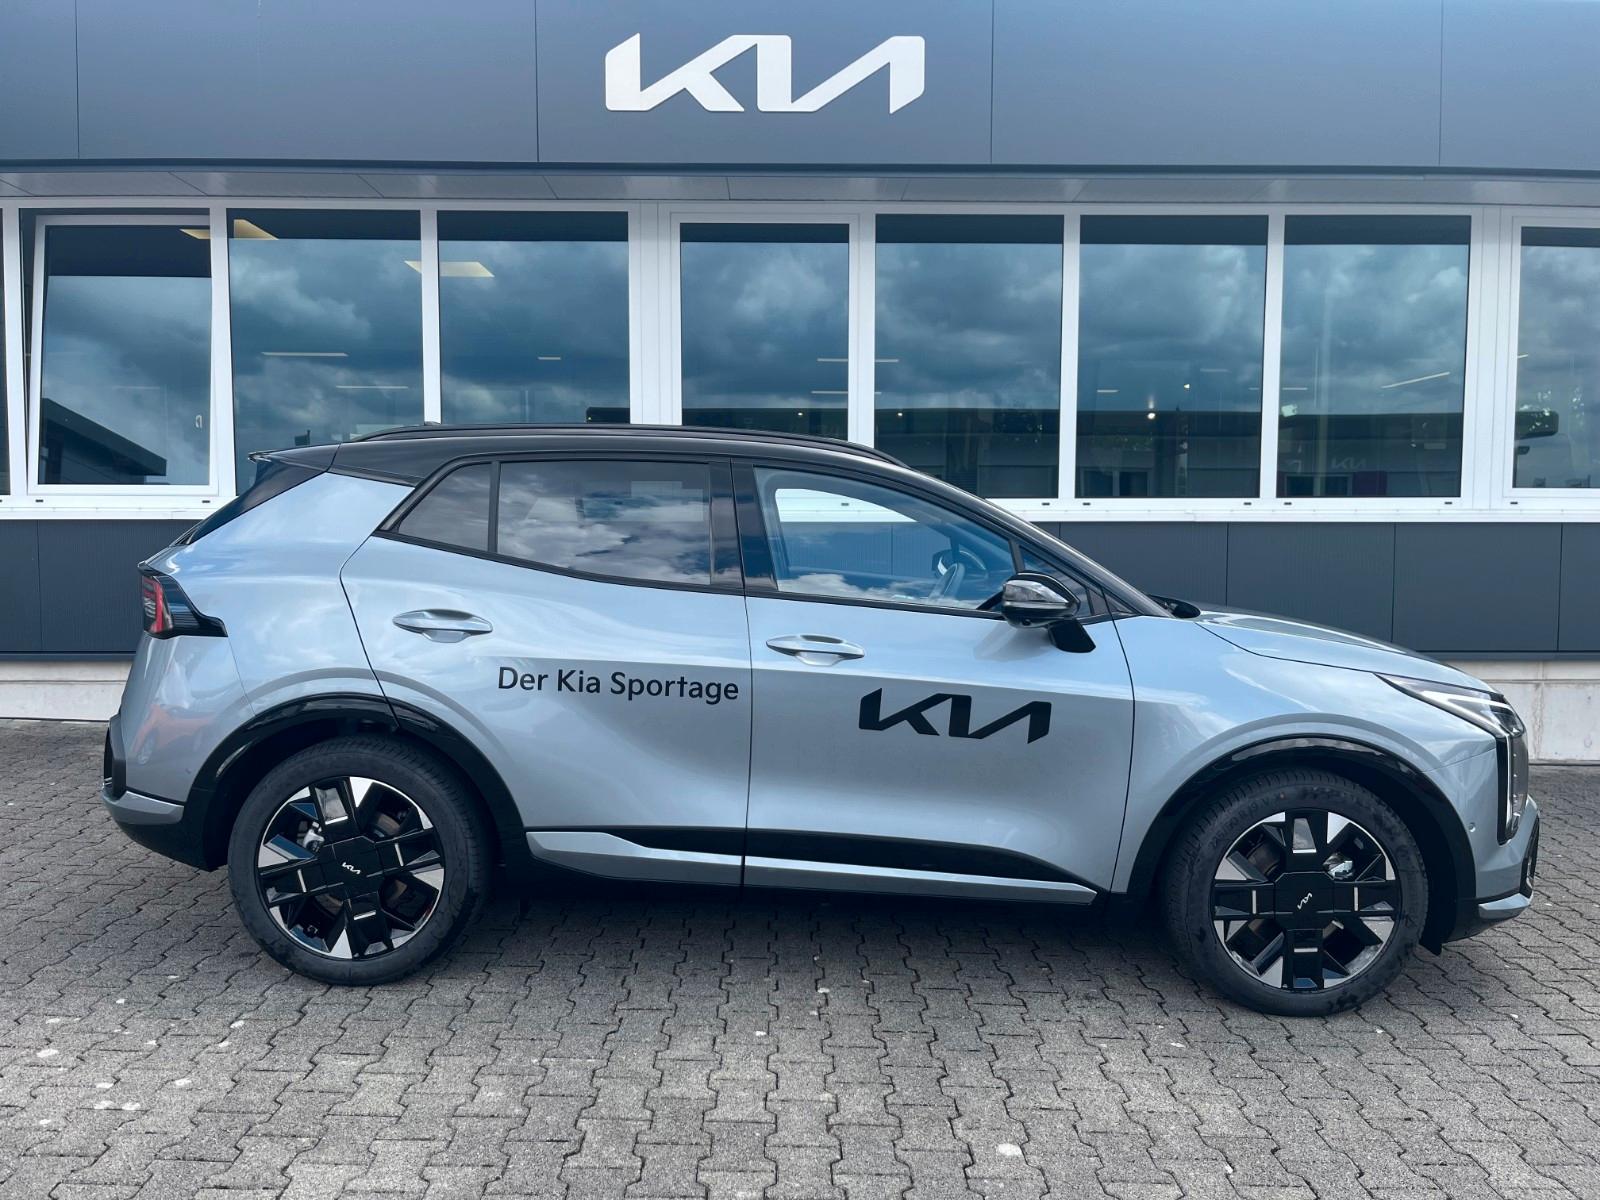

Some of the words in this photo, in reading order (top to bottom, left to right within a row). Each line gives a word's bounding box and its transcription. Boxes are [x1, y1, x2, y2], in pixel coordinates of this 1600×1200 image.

[605, 32, 925, 114] KIA
[498, 666, 549, 691] Der
[557, 668, 601, 694] Kia
[610, 671, 739, 705] Sportage
[858, 687, 1052, 744] KIA
